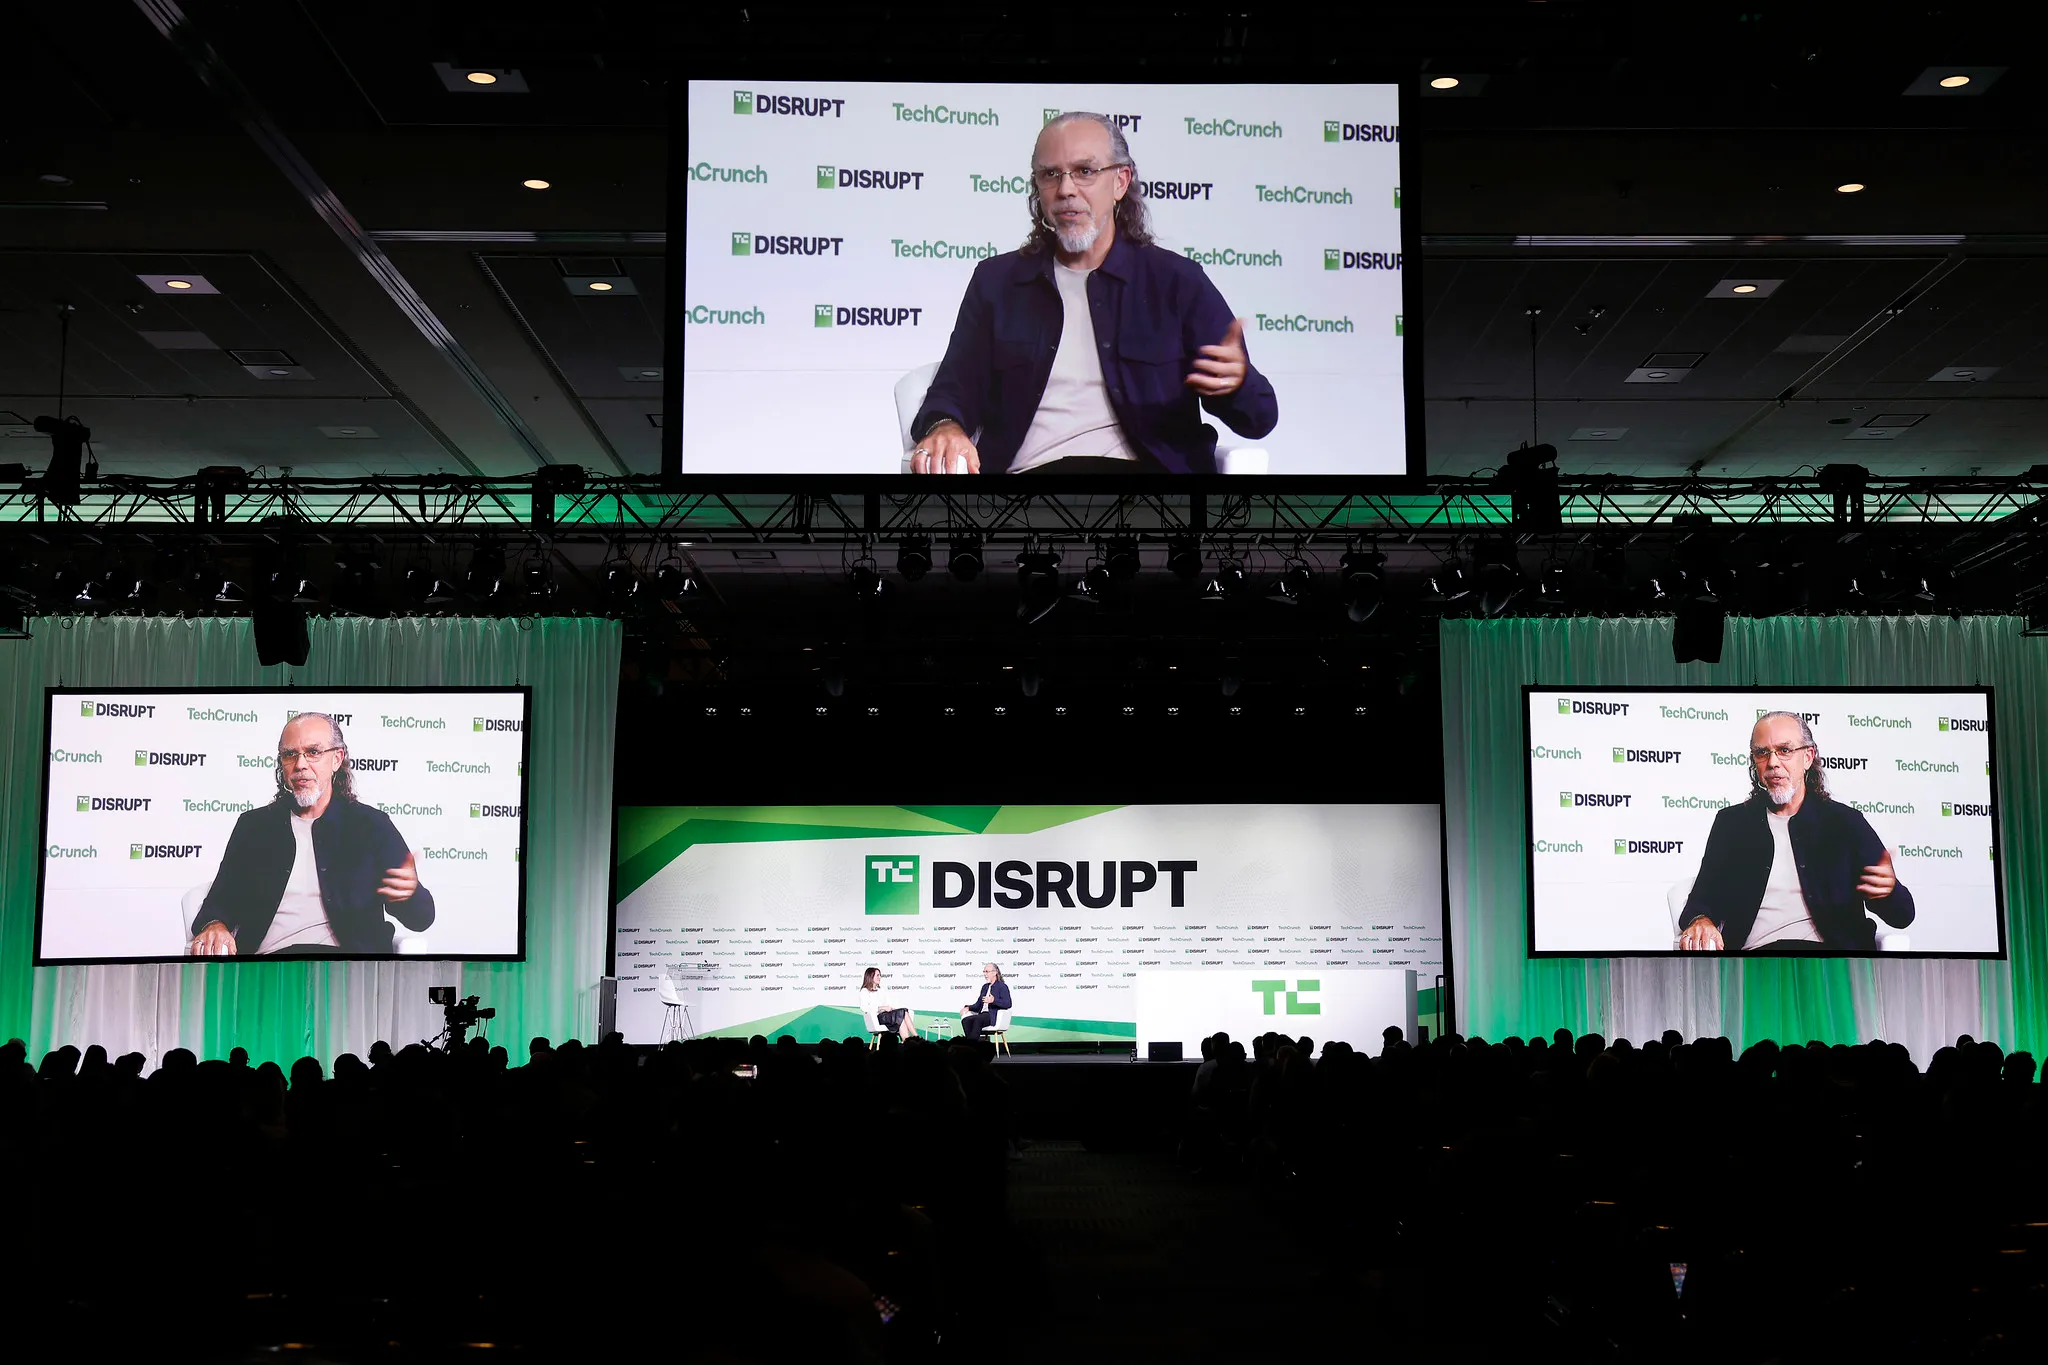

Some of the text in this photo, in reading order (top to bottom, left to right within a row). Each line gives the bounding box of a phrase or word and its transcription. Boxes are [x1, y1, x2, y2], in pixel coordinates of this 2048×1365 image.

[756, 95, 845, 118] DISRUPT
[893, 103, 999, 126] TechCrunch
[1184, 117, 1282, 138] TechCrunch
[839, 169, 924, 190] DISRUPT
[1255, 185, 1352, 205] TechCrunch
[754, 235, 843, 256] DISRUPT
[891, 239, 998, 259] TechCrunch
[1184, 248, 1282, 267] TechCrunch
[836, 307, 922, 328] DISRUPT
[1256, 314, 1354, 333] TechCrunch
[96, 703, 156, 719] DISRUPT
[187, 708, 258, 722] TechCrunch
[1572, 701, 1629, 716] DISRUPT
[1659, 706, 1728, 721] TechCrunch
[381, 716, 445, 729] TechCrunch
[1848, 715, 1911, 729] TechCrunch
[149, 752, 206, 766] DISRUPT
[1627, 750, 1681, 763] DISRUPT
[426, 761, 490, 774] TechCrunch
[1895, 760, 1959, 774] TechCrunch
[92, 798, 151, 811] DISRUPT
[183, 799, 254, 812] TechCrunch
[1574, 794, 1631, 807] DISRUPT
[1662, 796, 1730, 809] TechCrunch
[144, 845, 202, 858] DISRUPT
[423, 847, 487, 860] TechCrunch
[1628, 841, 1683, 854] DISRUPT
[1898, 845, 1962, 858] TechCrunch
[872, 860, 1198, 908] TC DISRUPT
[1252, 979, 1320, 1015] TC
